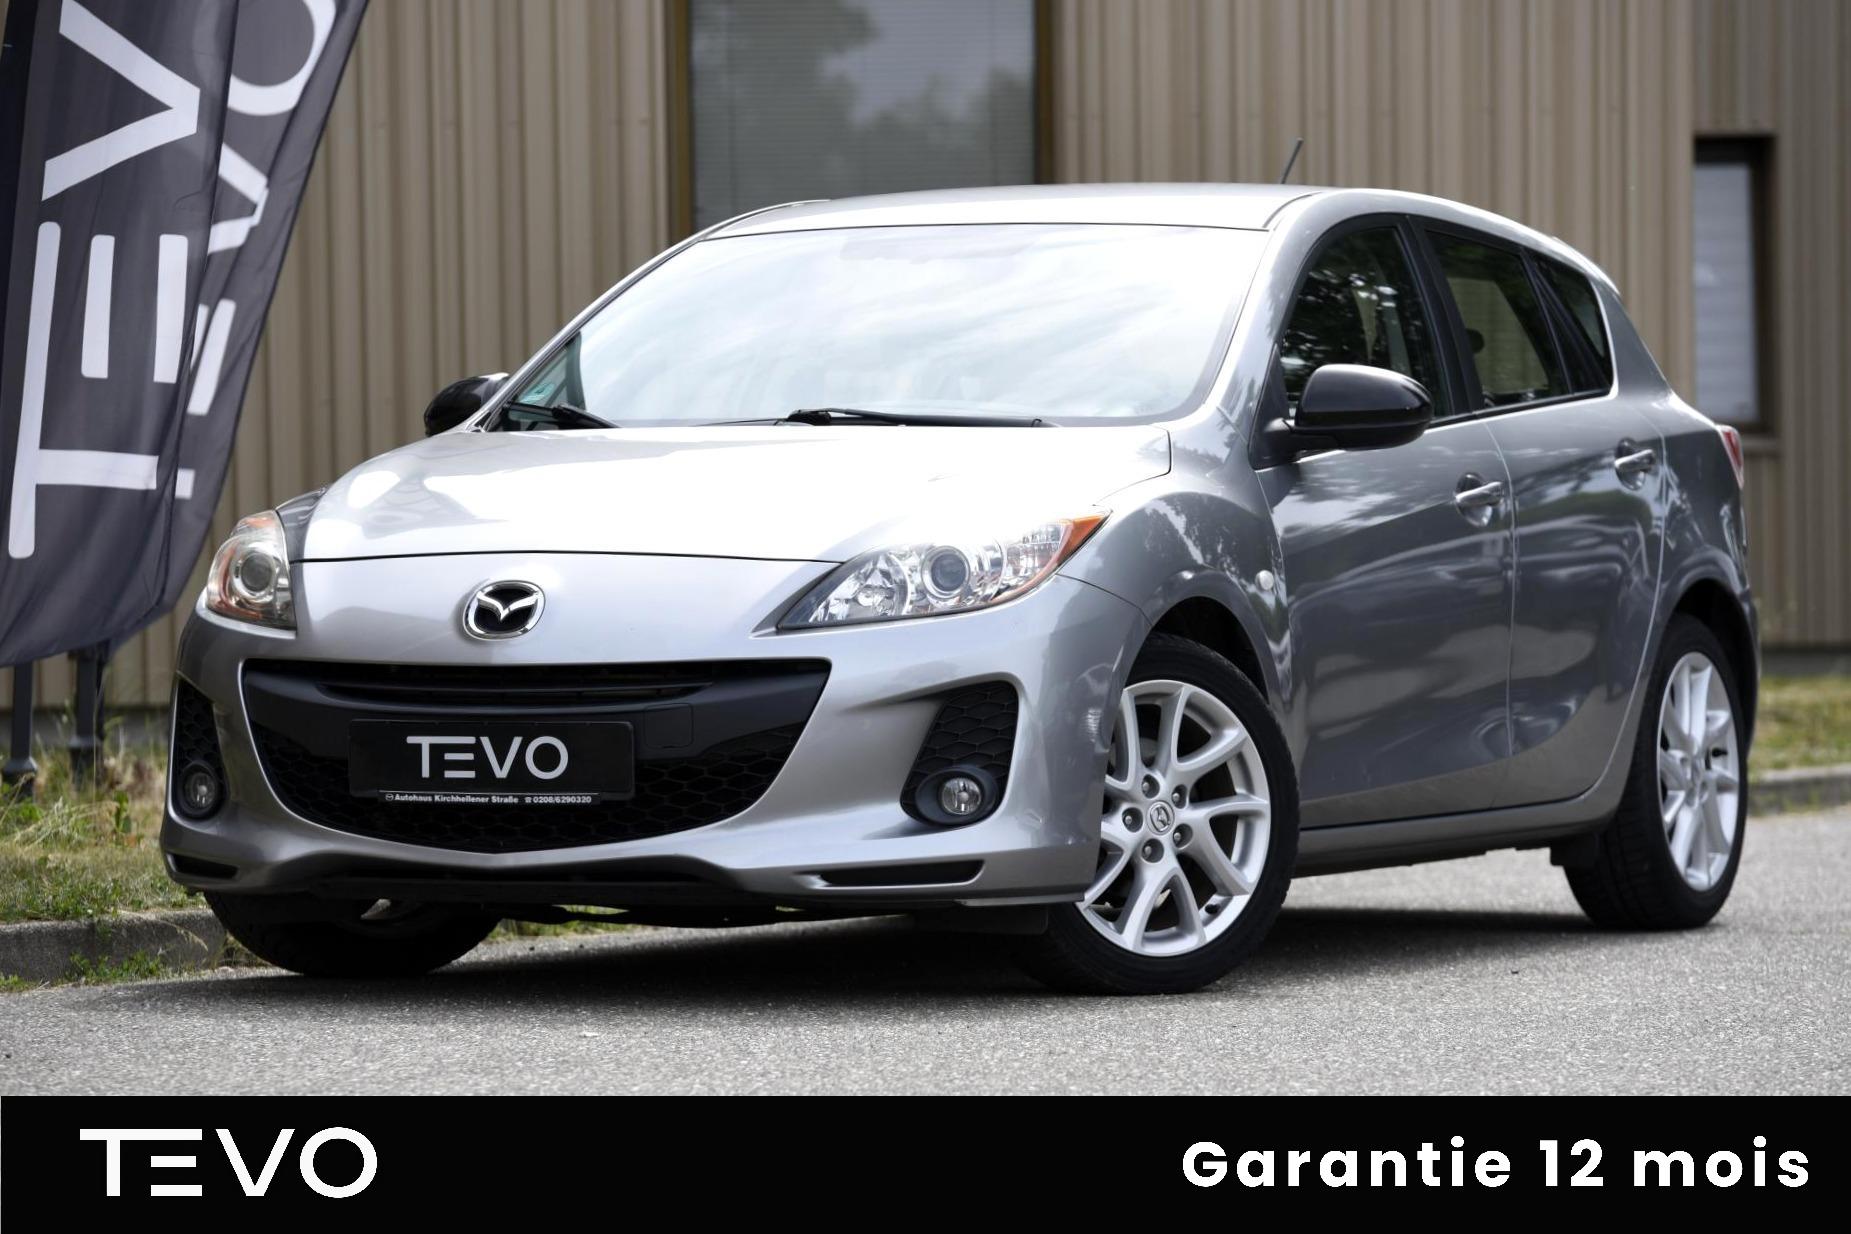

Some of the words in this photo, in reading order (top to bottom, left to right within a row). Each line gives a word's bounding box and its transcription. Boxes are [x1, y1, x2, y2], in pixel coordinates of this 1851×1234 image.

[406, 735, 569, 780] TEVO
[394, 793, 433, 802] Autohaus
[491, 795, 519, 804] Straße
